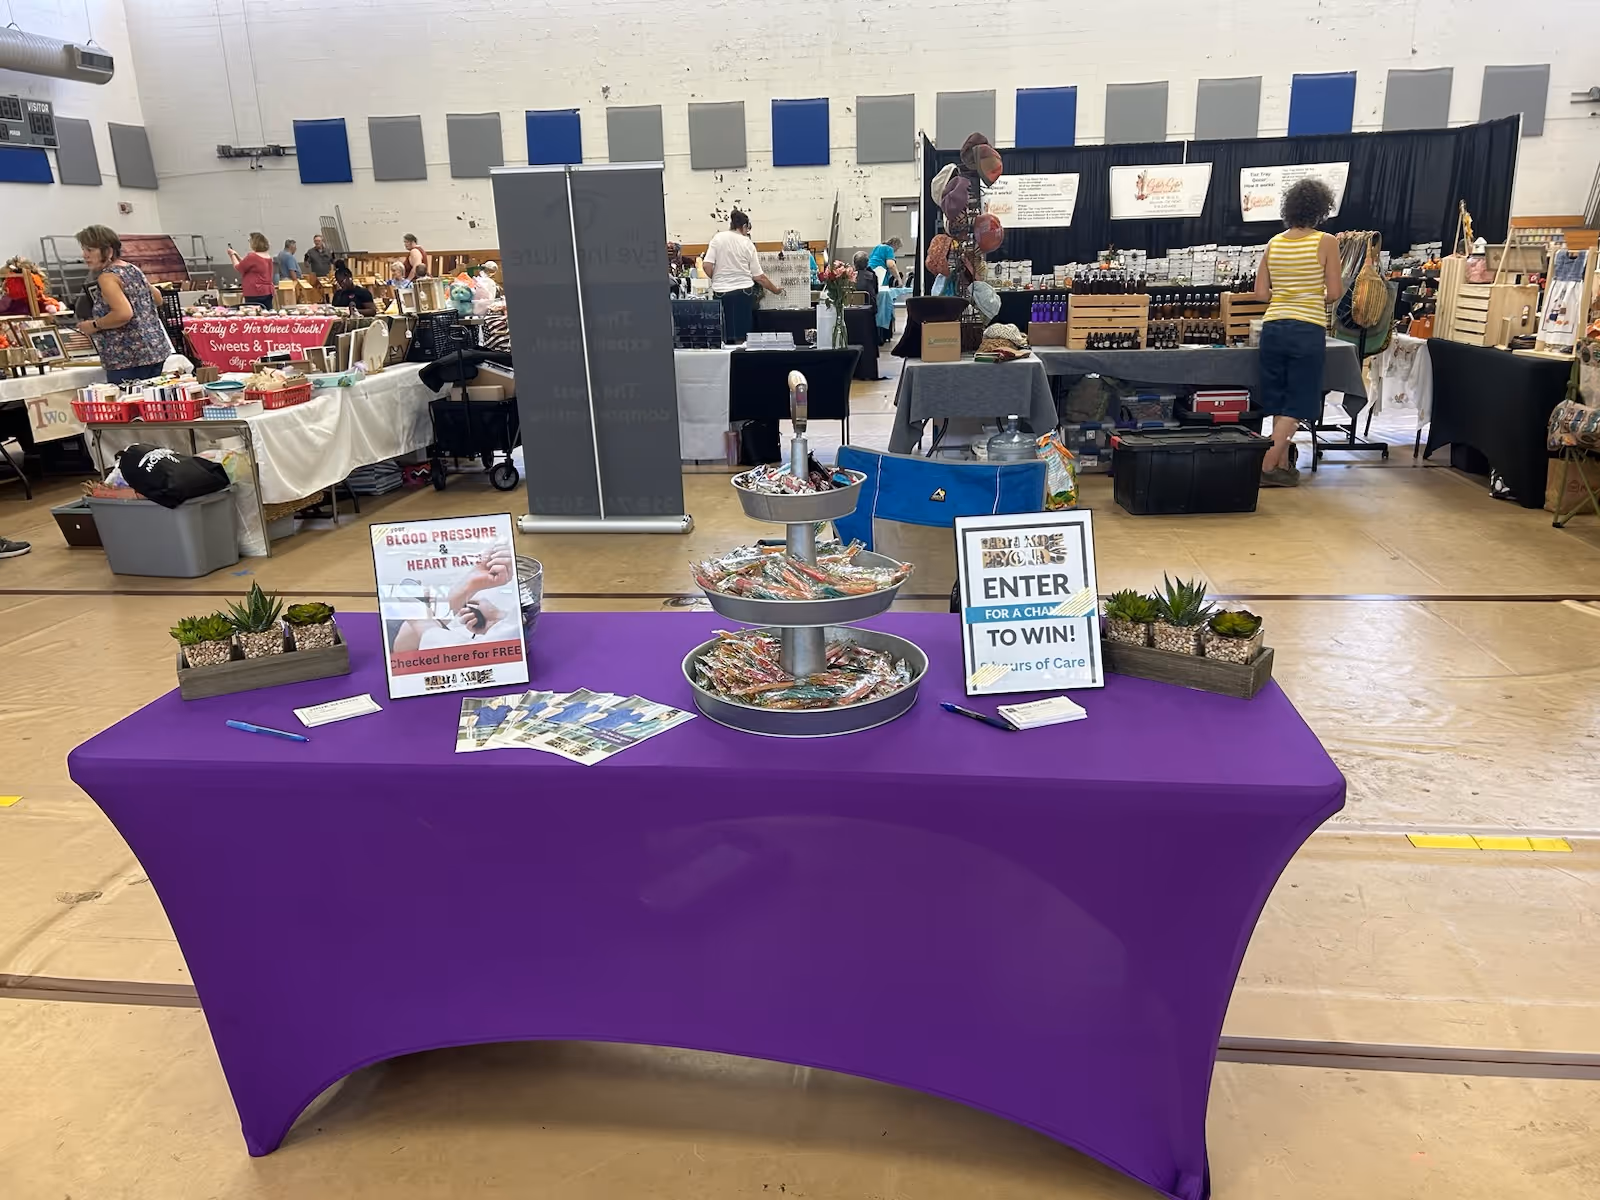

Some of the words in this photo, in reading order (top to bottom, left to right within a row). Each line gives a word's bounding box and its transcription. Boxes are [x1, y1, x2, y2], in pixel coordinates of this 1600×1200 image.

[27, 101, 50, 113] VISITOR
[184, 323, 197, 334] A
[200, 323, 227, 339] Lady
[229, 323, 238, 333] &
[242, 322, 261, 334] Her
[263, 323, 289, 334] Sweet
[292, 322, 325, 334] Tooth!
[210, 340, 250, 352] Sweets
[253, 340, 262, 352] &
[264, 340, 302, 352] Treats
[229, 356, 247, 370] By:
[386, 533, 427, 546] BLOOD
[432, 526, 496, 542] PRESSURE
[439, 544, 448, 554] &
[407, 557, 448, 571] HEART
[452, 554, 482, 567] RA
[983, 573, 1071, 599] ENTER
[985, 608, 1010, 620] FOR
[1012, 608, 1022, 618] A
[986, 628, 1017, 647] TO
[1020, 624, 1076, 645] WIN!
[391, 654, 440, 669] Checked
[443, 650, 470, 663] here
[472, 648, 490, 660] for
[492, 645, 522, 657] FREE
[1035, 658, 1050, 670] of
[1053, 657, 1086, 669] Care
